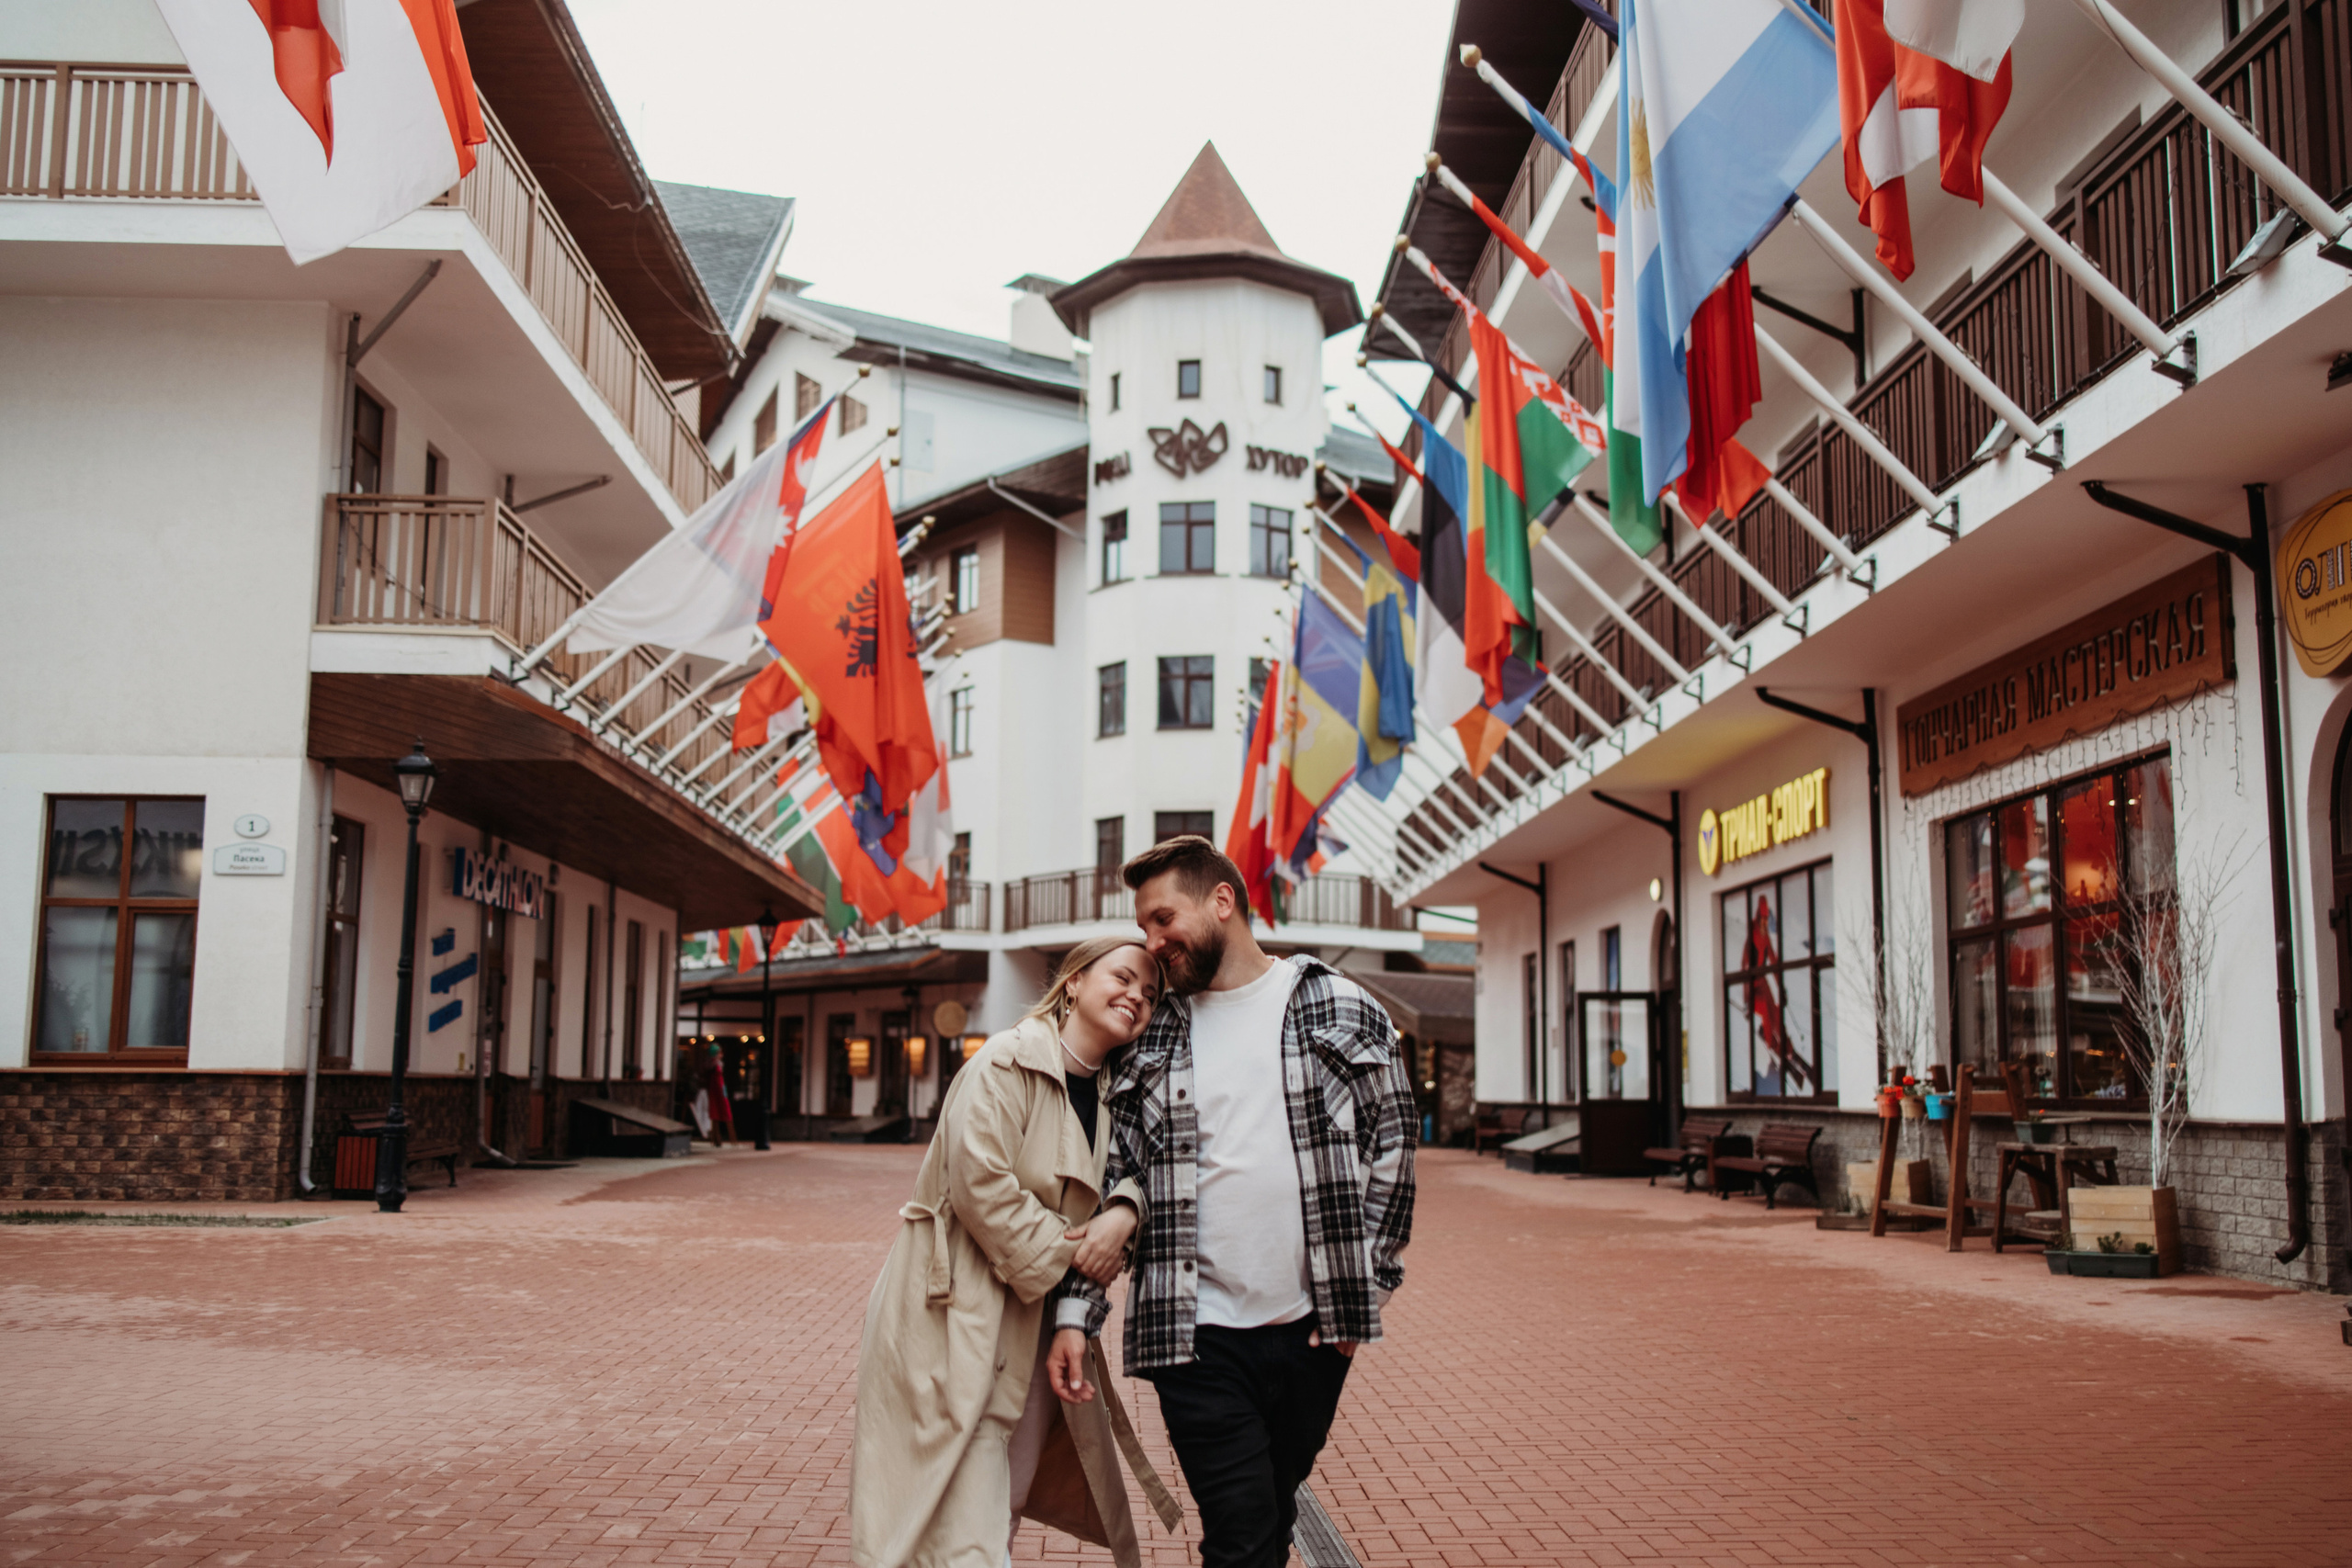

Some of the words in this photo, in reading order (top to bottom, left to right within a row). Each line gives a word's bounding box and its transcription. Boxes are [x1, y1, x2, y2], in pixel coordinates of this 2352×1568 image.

[2295, 538, 2352, 600] ОЛГ
[1904, 676, 2018, 773] ГОНЧАРНАЯ
[2025, 592, 2207, 724] МАСТЕРСКАЯ
[248, 820, 254, 832] 1
[233, 854, 266, 863] Пасека
[461, 848, 545, 920] DECATHLON
